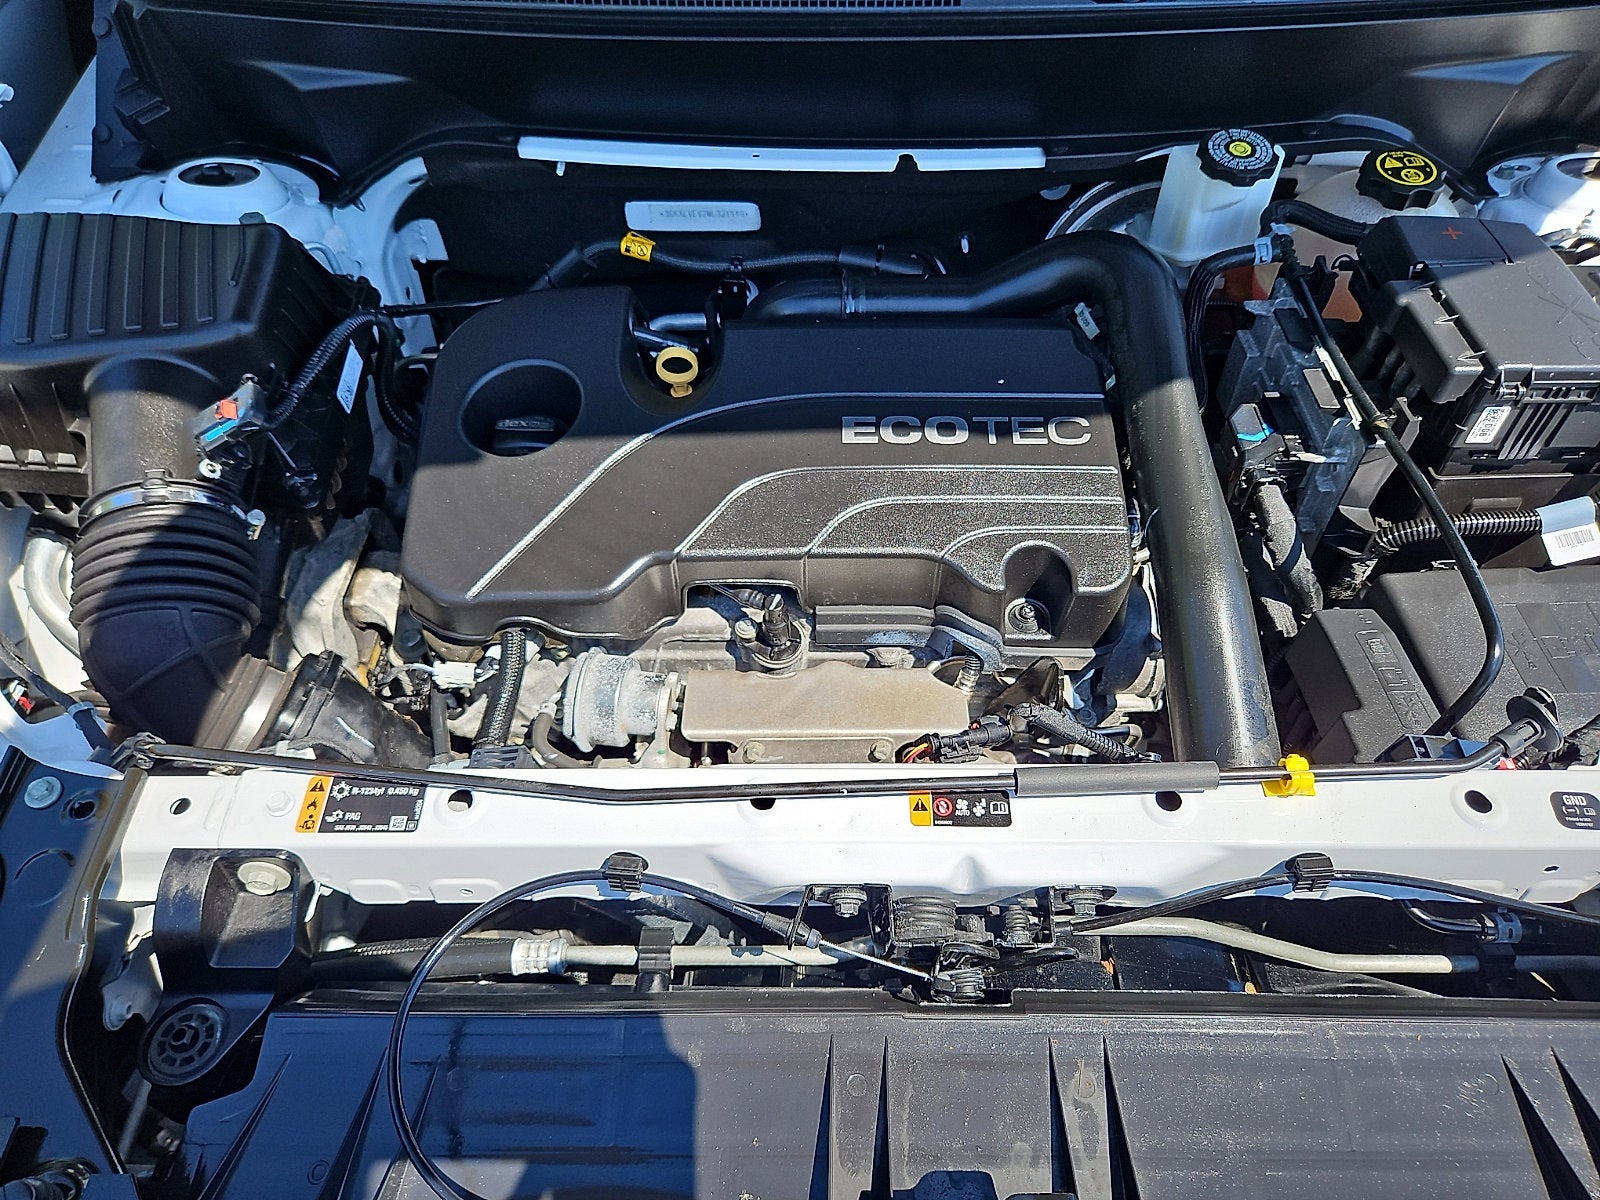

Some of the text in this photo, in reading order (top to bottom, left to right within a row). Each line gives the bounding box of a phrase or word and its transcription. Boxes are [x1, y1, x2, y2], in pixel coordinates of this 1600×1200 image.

[841, 415, 1092, 446] ECOTEC
[1562, 794, 1587, 806] GND
[344, 812, 362, 821] PAG
[954, 809, 971, 817] AUTO
